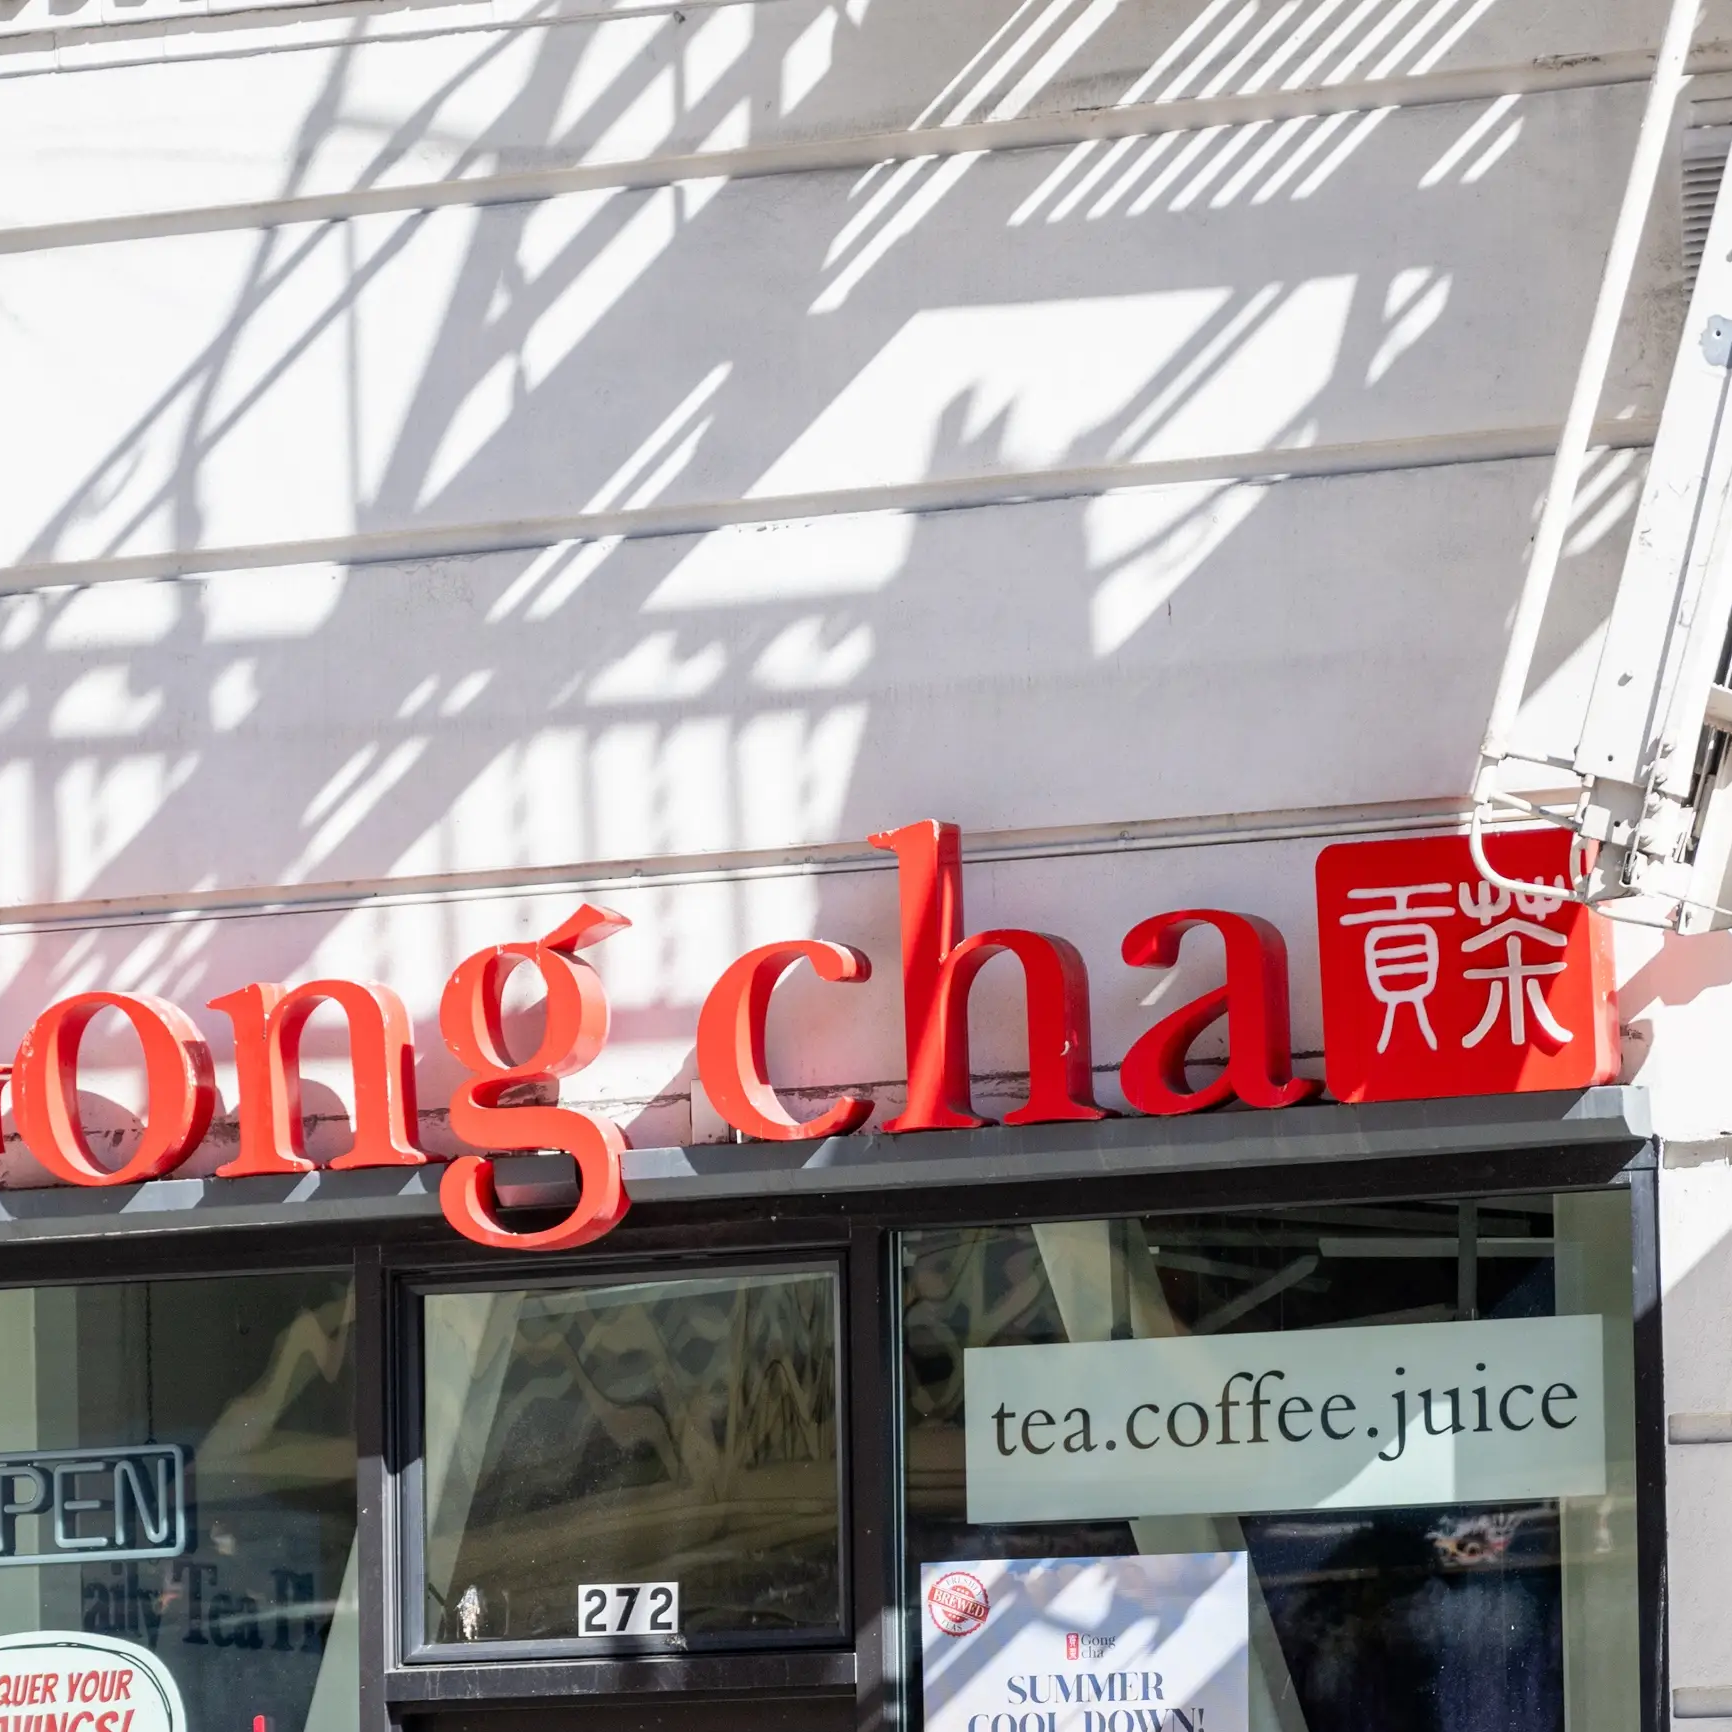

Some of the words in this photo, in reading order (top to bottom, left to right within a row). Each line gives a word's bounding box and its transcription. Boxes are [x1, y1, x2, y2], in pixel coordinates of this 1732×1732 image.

[696, 818, 1325, 1141] cha
[1339, 874, 1575, 1054] 貢茶
[991, 1362, 1578, 1462] tea.coffee.juice
[584, 1586, 674, 1633] 272
[932, 1588, 985, 1618] BREWED
[1080, 1633, 1116, 1649] Gong
[1081, 1645, 1104, 1659] cha
[67, 1669, 134, 1704] YOUR
[1007, 1671, 1165, 1705] SUMMER
